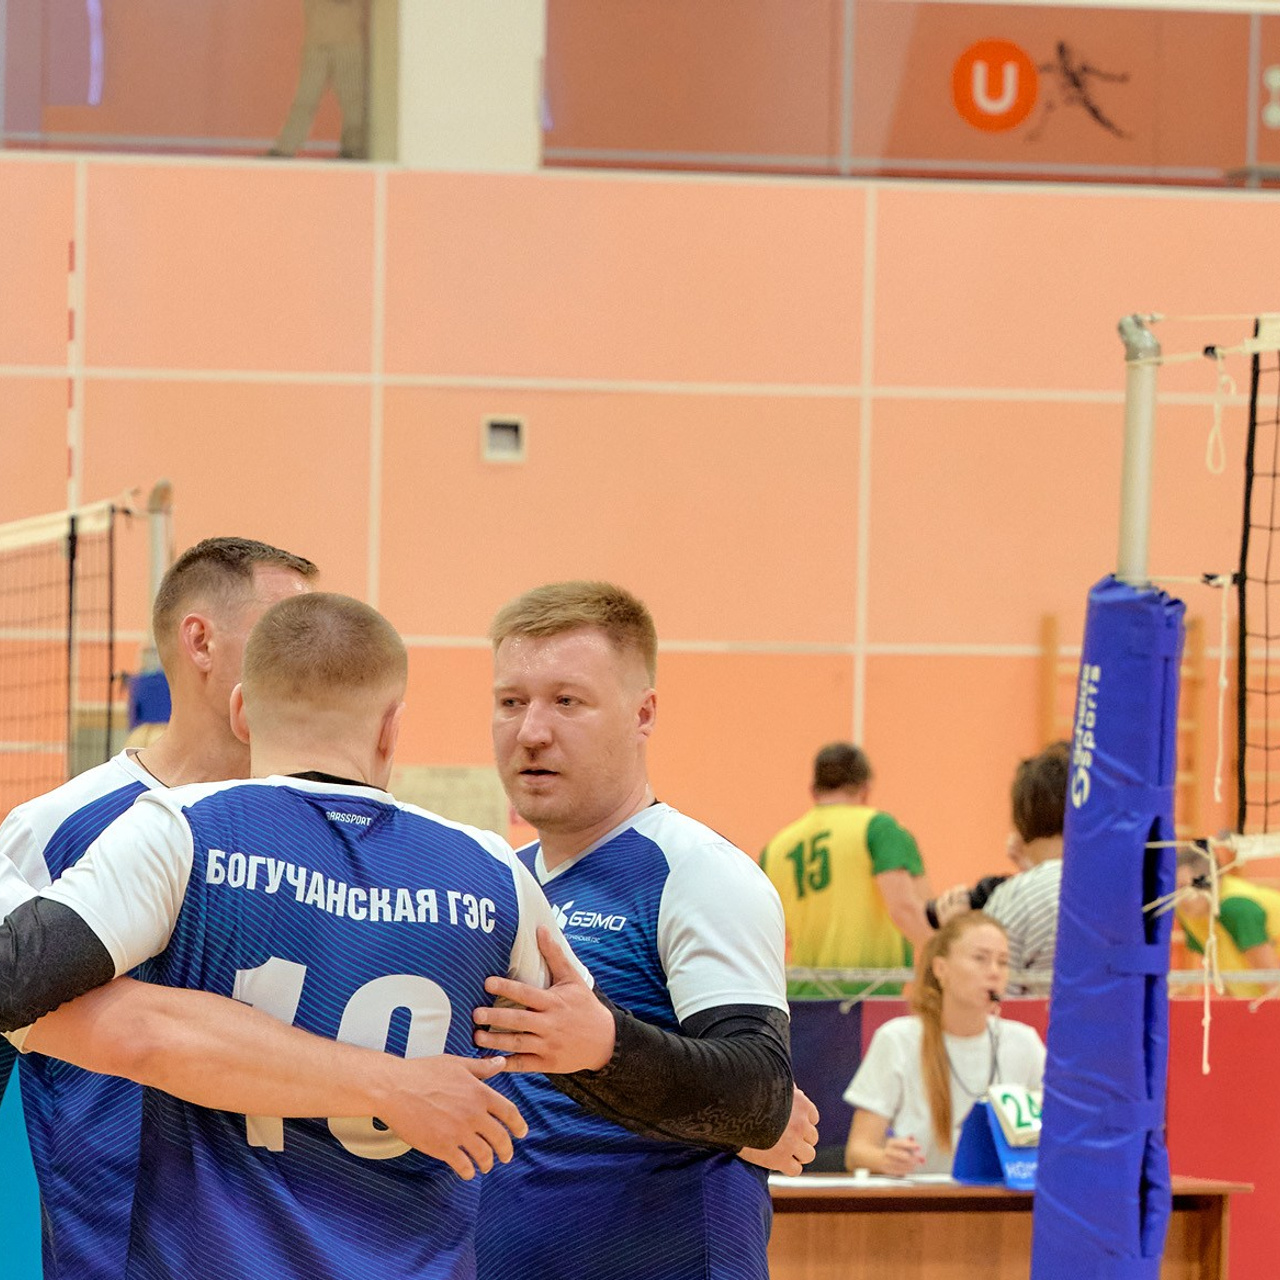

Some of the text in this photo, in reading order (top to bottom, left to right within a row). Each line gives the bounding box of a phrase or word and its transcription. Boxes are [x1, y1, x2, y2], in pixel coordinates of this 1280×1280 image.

[972, 59, 1018, 114] U
[1079, 664, 1102, 769] Sports
[205, 849, 496, 934] БОГУЧАНСКАЯ ГЭС
[784, 830, 832, 901] 15
